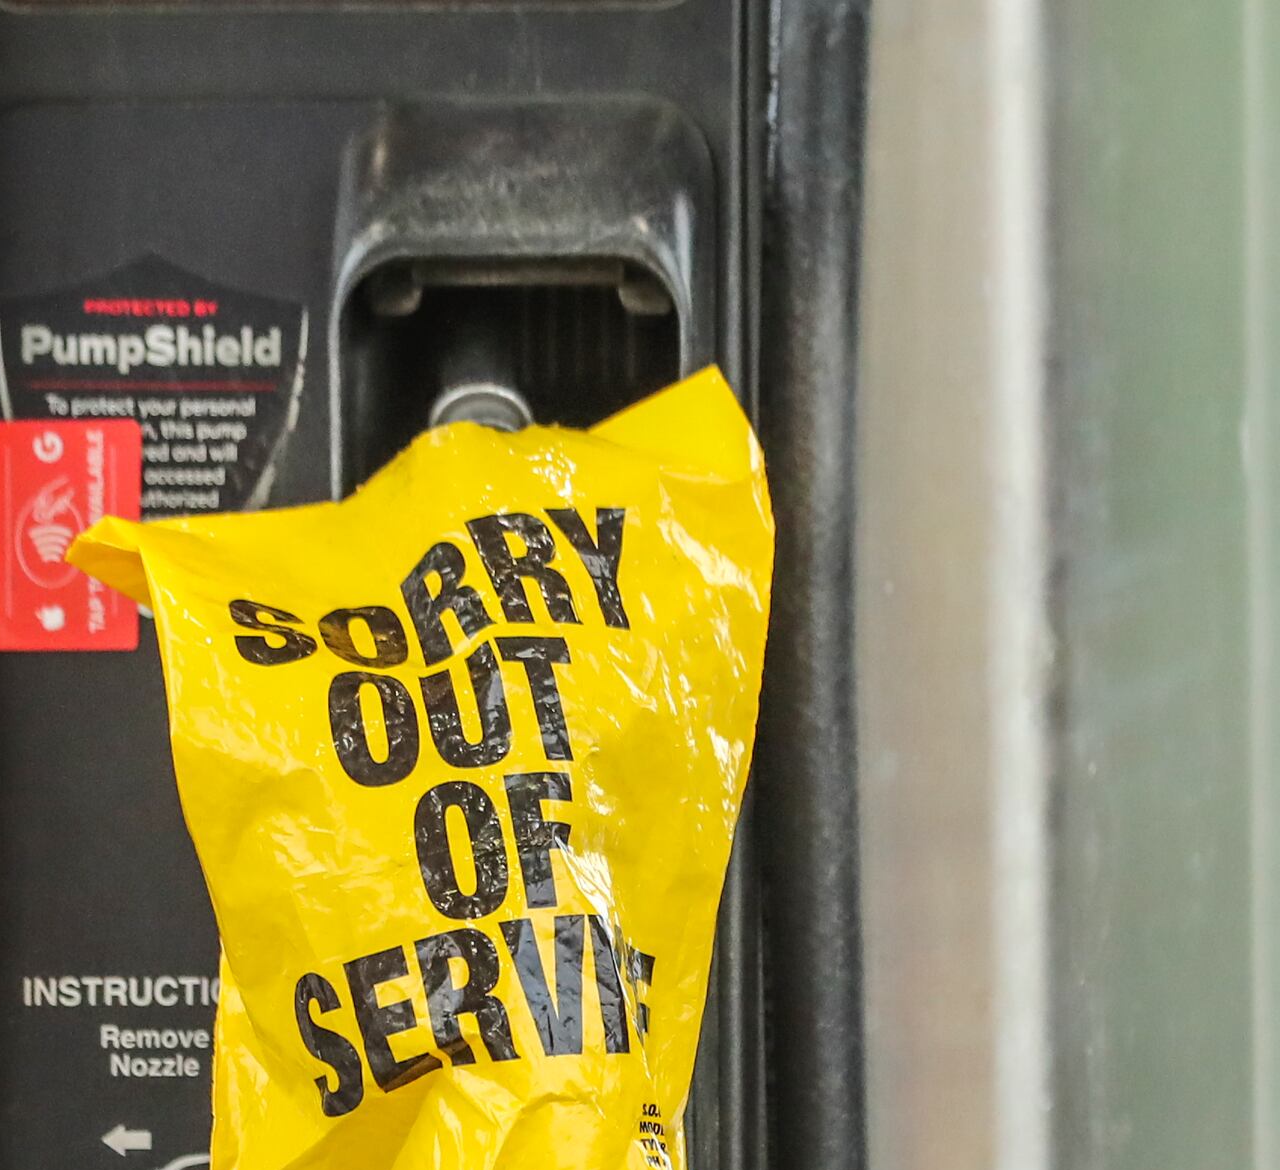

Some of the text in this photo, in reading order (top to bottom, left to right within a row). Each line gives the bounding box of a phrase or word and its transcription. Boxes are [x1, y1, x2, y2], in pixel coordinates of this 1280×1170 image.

[83, 298, 218, 317] PROTECTED BY
[21, 324, 282, 375] PumpShield
[46, 393, 256, 420] To protect your personal
[159, 419, 195, 440] this
[195, 421, 248, 443] pump
[171, 442, 207, 463] and
[208, 442, 238, 463] will
[144, 465, 227, 487] accessed
[229, 507, 630, 669] SORRY
[327, 635, 574, 788] OUT
[413, 771, 574, 922] OF
[99, 1023, 210, 1050] Remove
[109, 1053, 201, 1078] Nozzle
